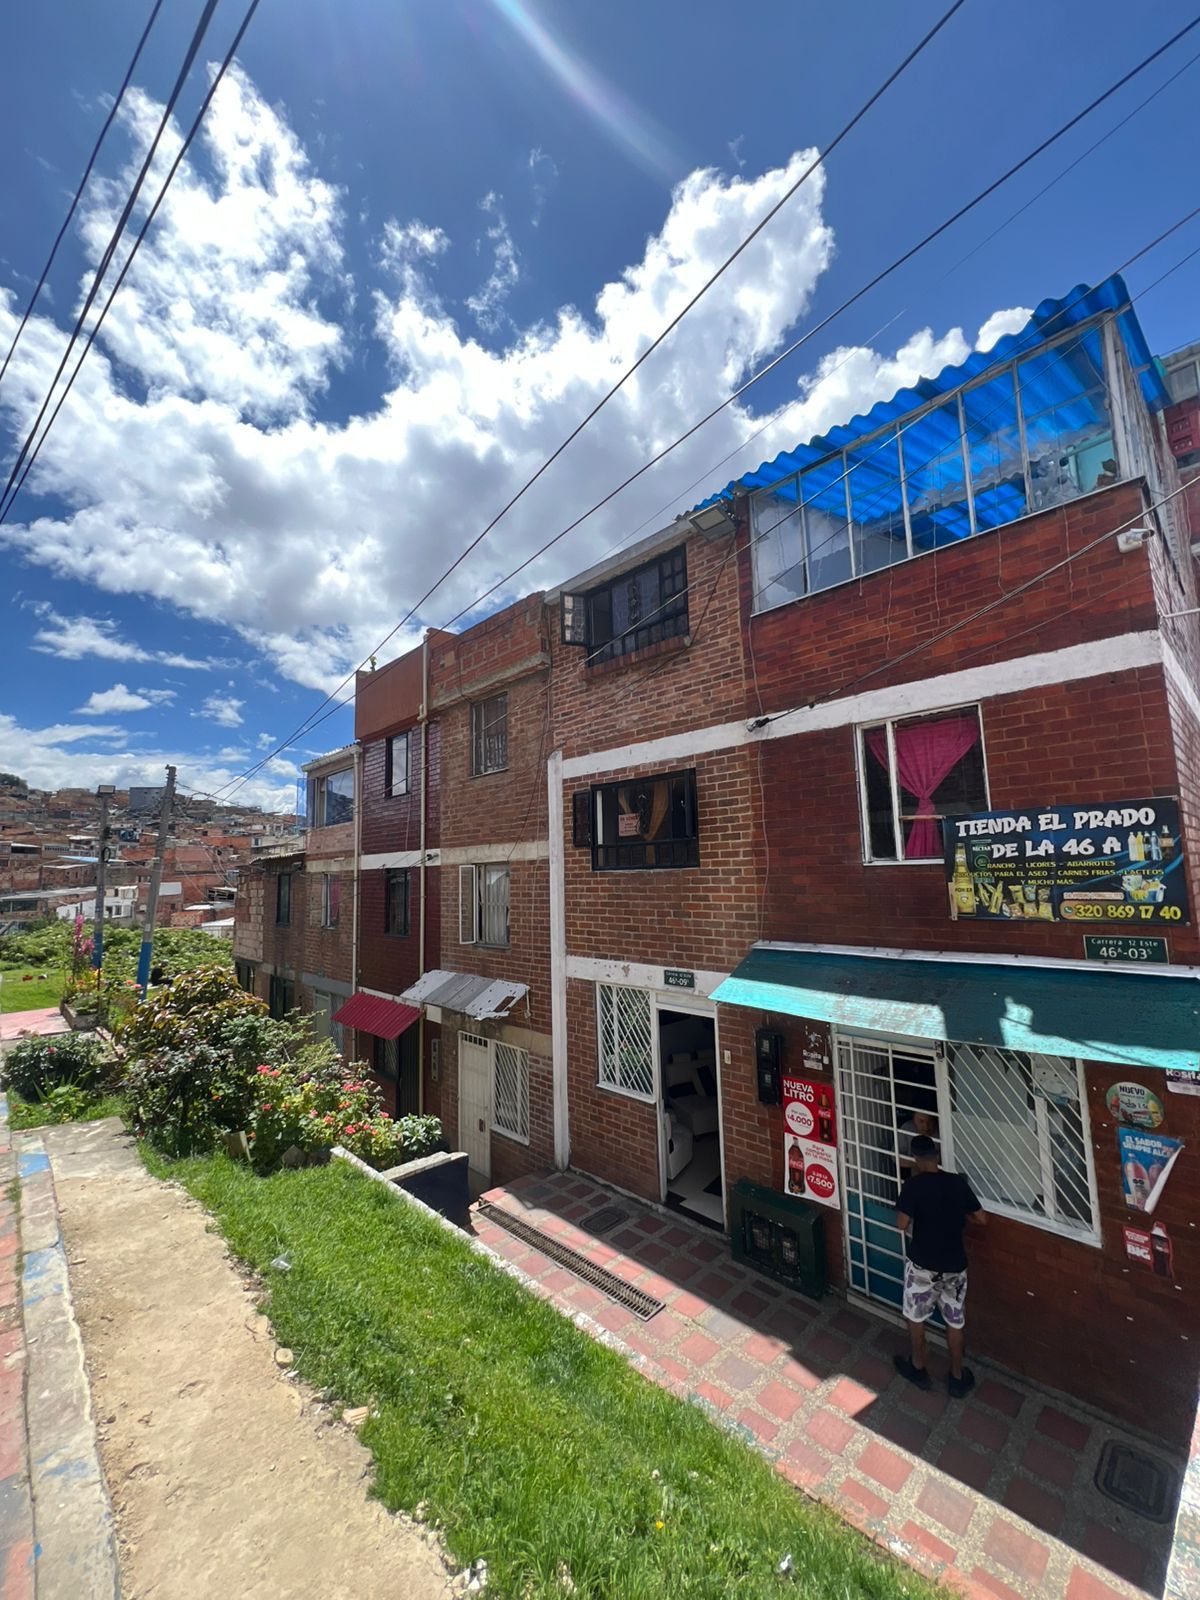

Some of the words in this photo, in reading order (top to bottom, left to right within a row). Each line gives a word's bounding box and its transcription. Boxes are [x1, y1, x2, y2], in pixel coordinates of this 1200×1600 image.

[955, 815, 1032, 837] TIENDA
[1037, 813, 1067, 832] EL
[1073, 807, 1156, 830] PRADO
[991, 843, 1019, 859] DE
[1025, 839, 1055, 857] LA
[1061, 838, 1095, 856] 46
[1102, 836, 1122, 855] A
[1075, 905, 1103, 918] 320
[1107, 905, 1135, 919] 869
[1139, 906, 1155, 919] 17
[1159, 906, 1182, 920] 40
[1091, 937, 1123, 945] Carrera
[783, 1079, 814, 1094] NUEVA
[1119, 1086, 1145, 1096] NUEVO
[784, 1087, 815, 1103] LITRO
[1134, 1137, 1162, 1147] SABOR
[1127, 1244, 1151, 1260] BIG
